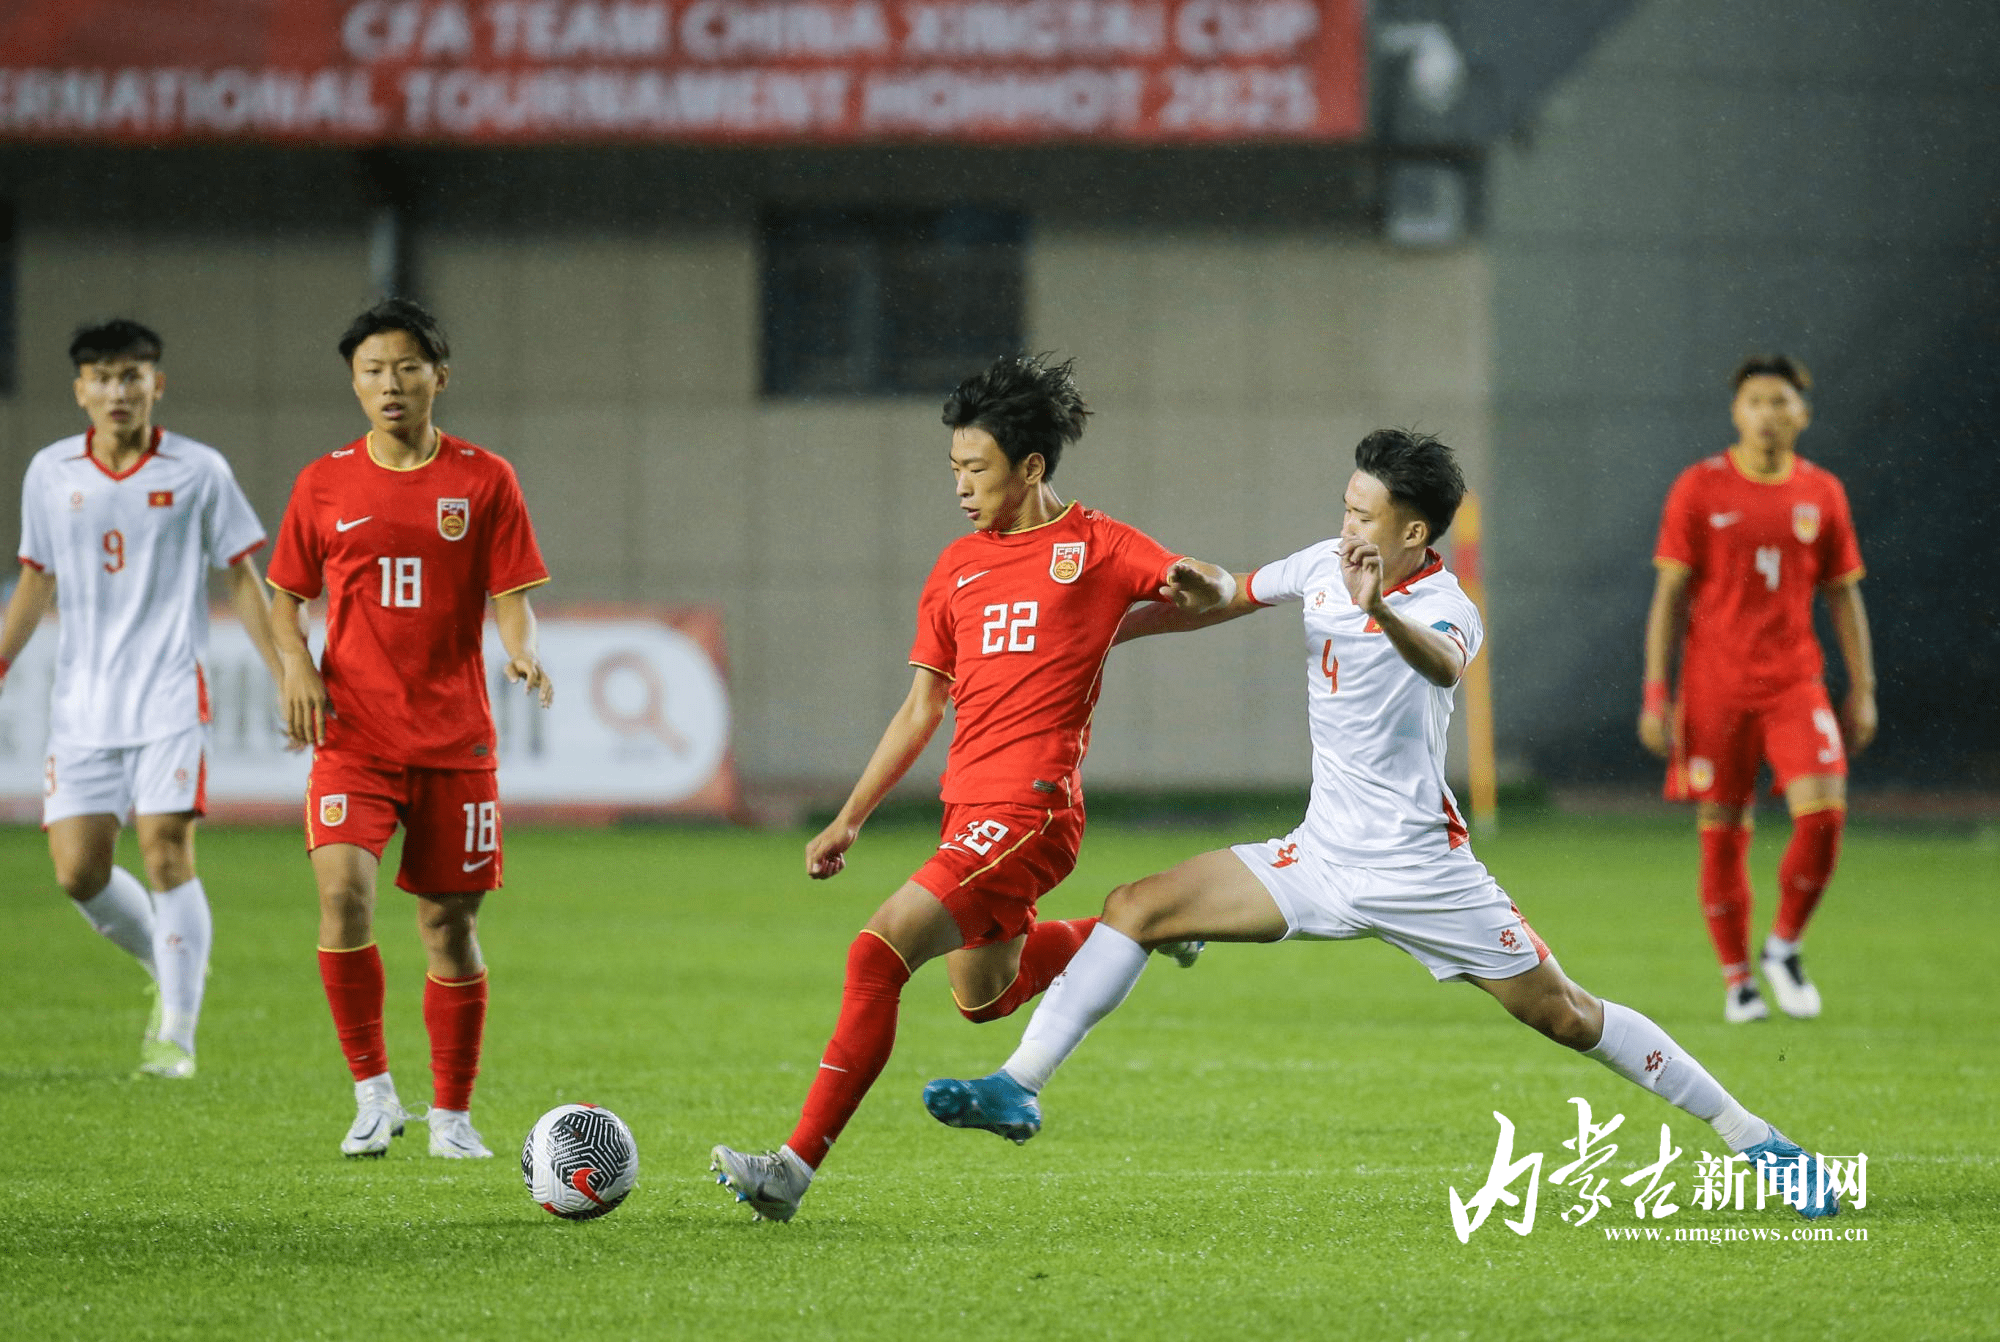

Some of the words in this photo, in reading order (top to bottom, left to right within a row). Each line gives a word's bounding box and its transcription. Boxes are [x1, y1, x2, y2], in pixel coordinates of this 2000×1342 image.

[483, 2, 672, 55] TEAM
[679, 2, 891, 56] CHINA
[1174, 2, 1318, 55] CUP
[402, 69, 850, 131] TOURNAMENT
[861, 69, 1144, 131] HOHHOT
[1162, 70, 1317, 131] 2025
[103, 529, 125, 573] 9
[1755, 546, 1781, 591] 4
[378, 557, 421, 607] 18
[981, 601, 1038, 655] 22
[1321, 639, 1339, 694] 4
[463, 801, 496, 852] 18
